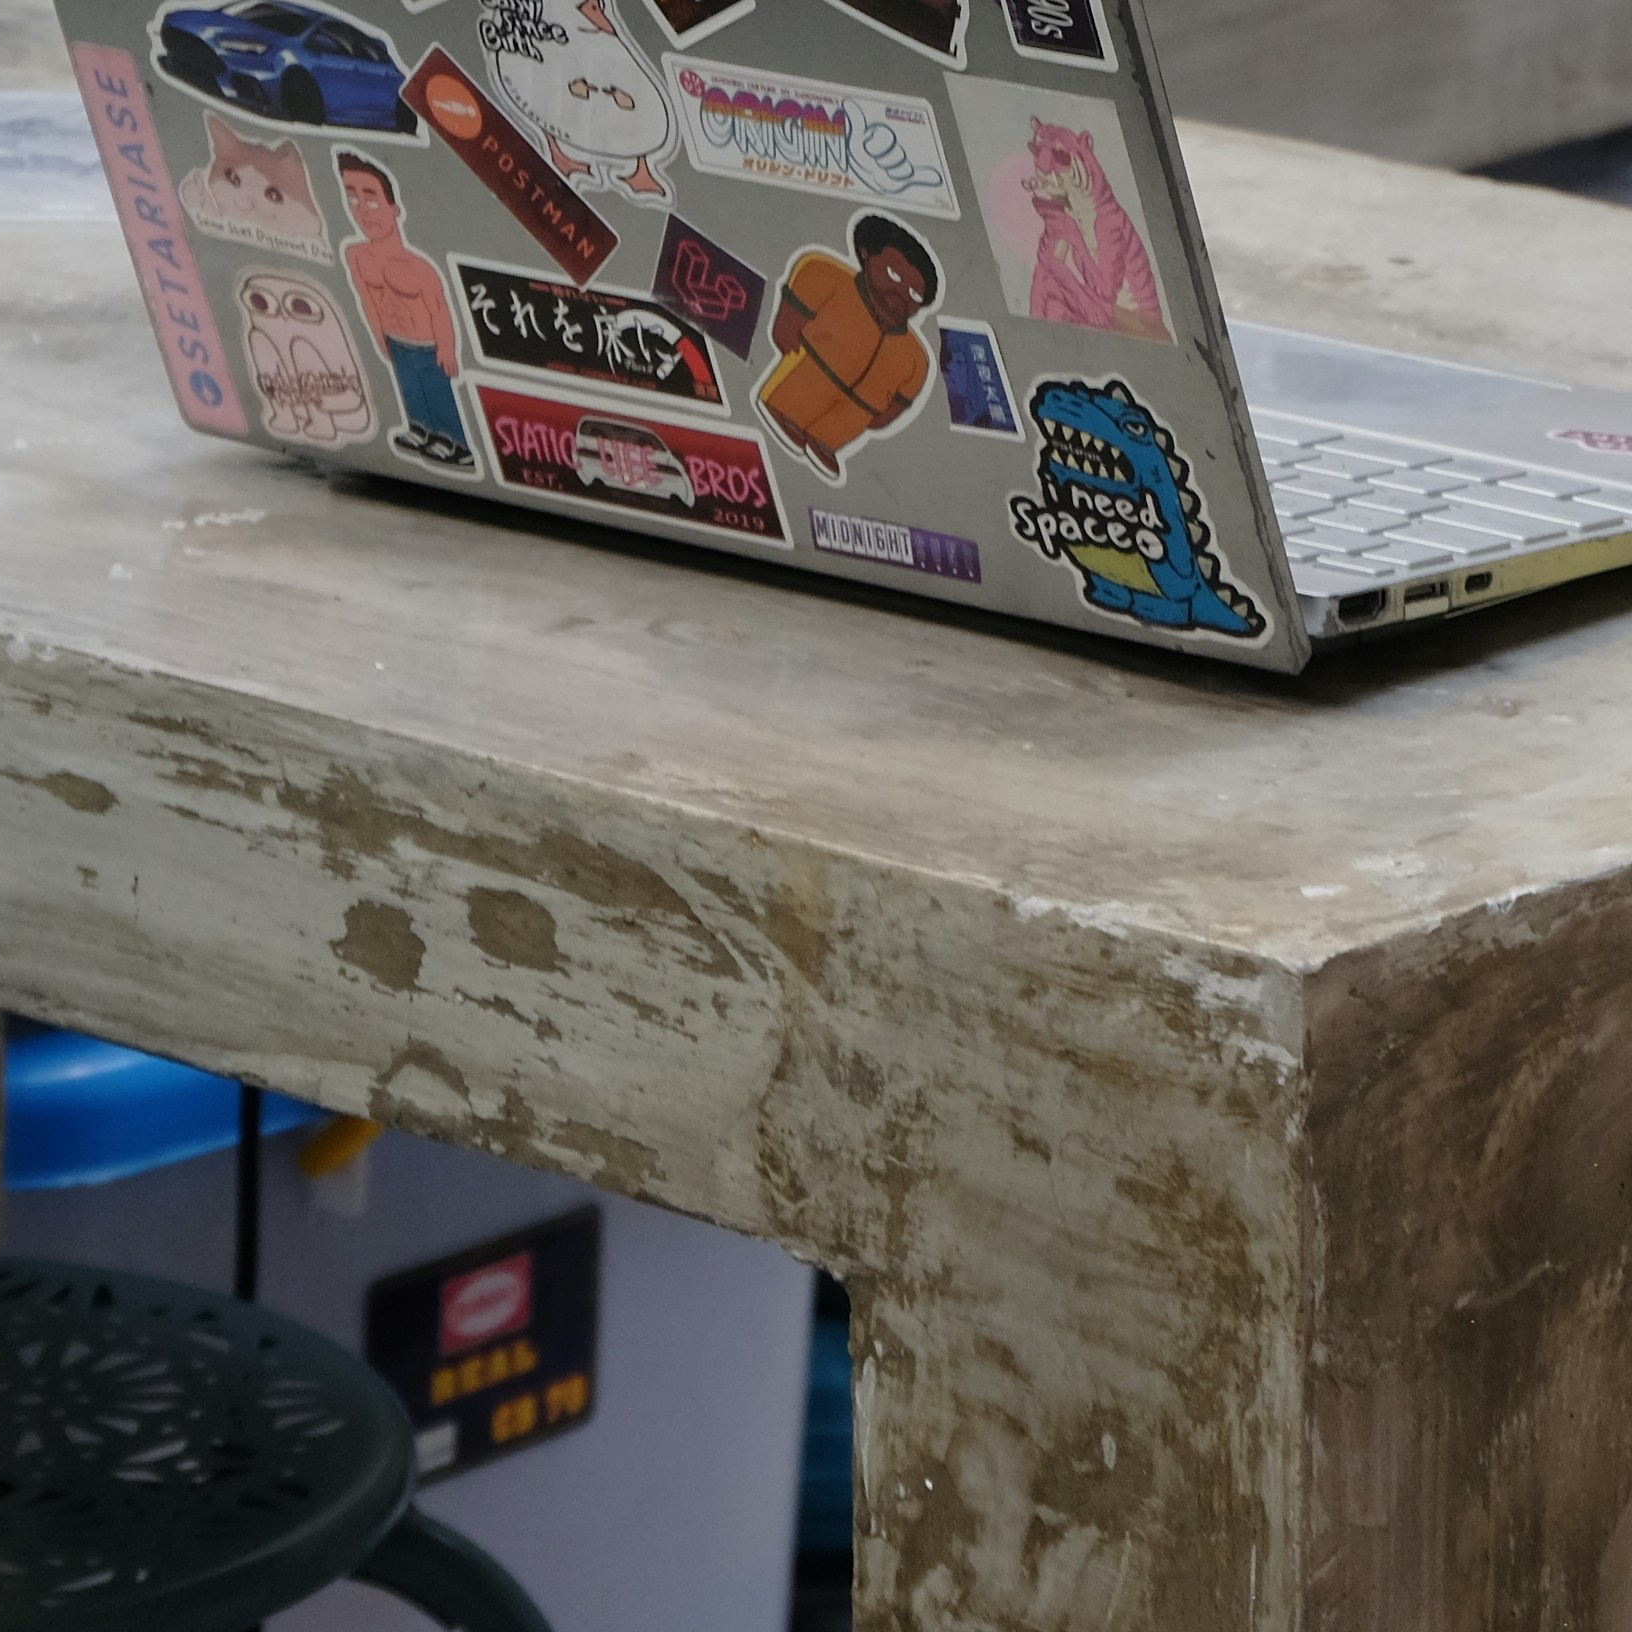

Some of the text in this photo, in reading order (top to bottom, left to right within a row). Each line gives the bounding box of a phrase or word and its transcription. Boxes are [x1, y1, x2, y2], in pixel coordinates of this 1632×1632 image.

[700, 87, 849, 173] ORIGIN
[95, 69, 210, 365] SETARIASE
[482, 135, 596, 259] POSTMAN
[684, 455, 767, 508] BROS
[1071, 484, 1164, 530] need
[713, 507, 765, 531] 2019
[815, 514, 911, 556] MIDNIGHT
